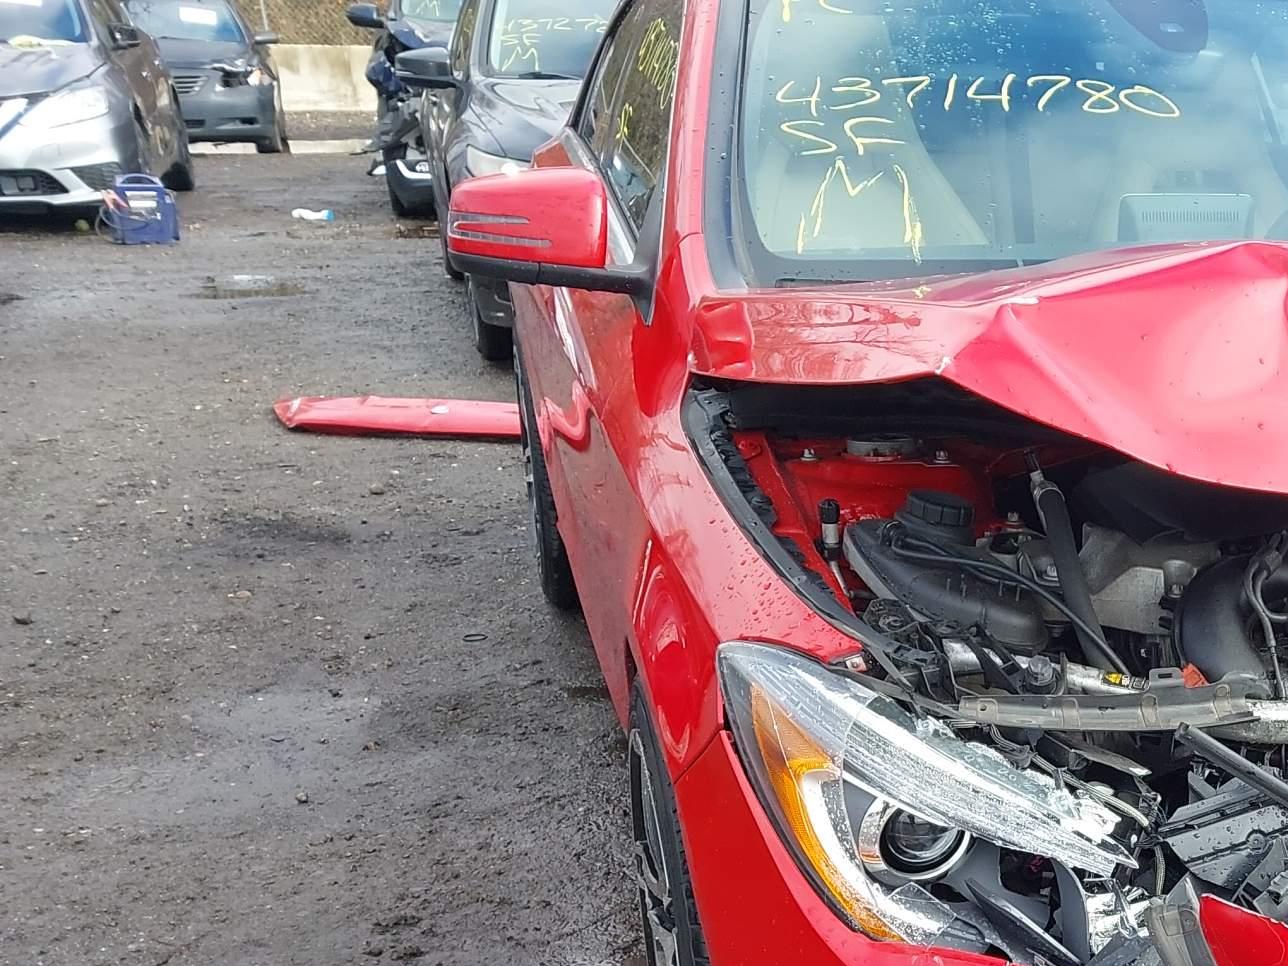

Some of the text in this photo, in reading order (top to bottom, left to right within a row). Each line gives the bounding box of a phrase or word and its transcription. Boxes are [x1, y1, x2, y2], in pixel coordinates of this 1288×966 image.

[501, 46, 539, 72] M
[776, 74, 1180, 117] 43714780
[780, 116, 905, 155] SF
